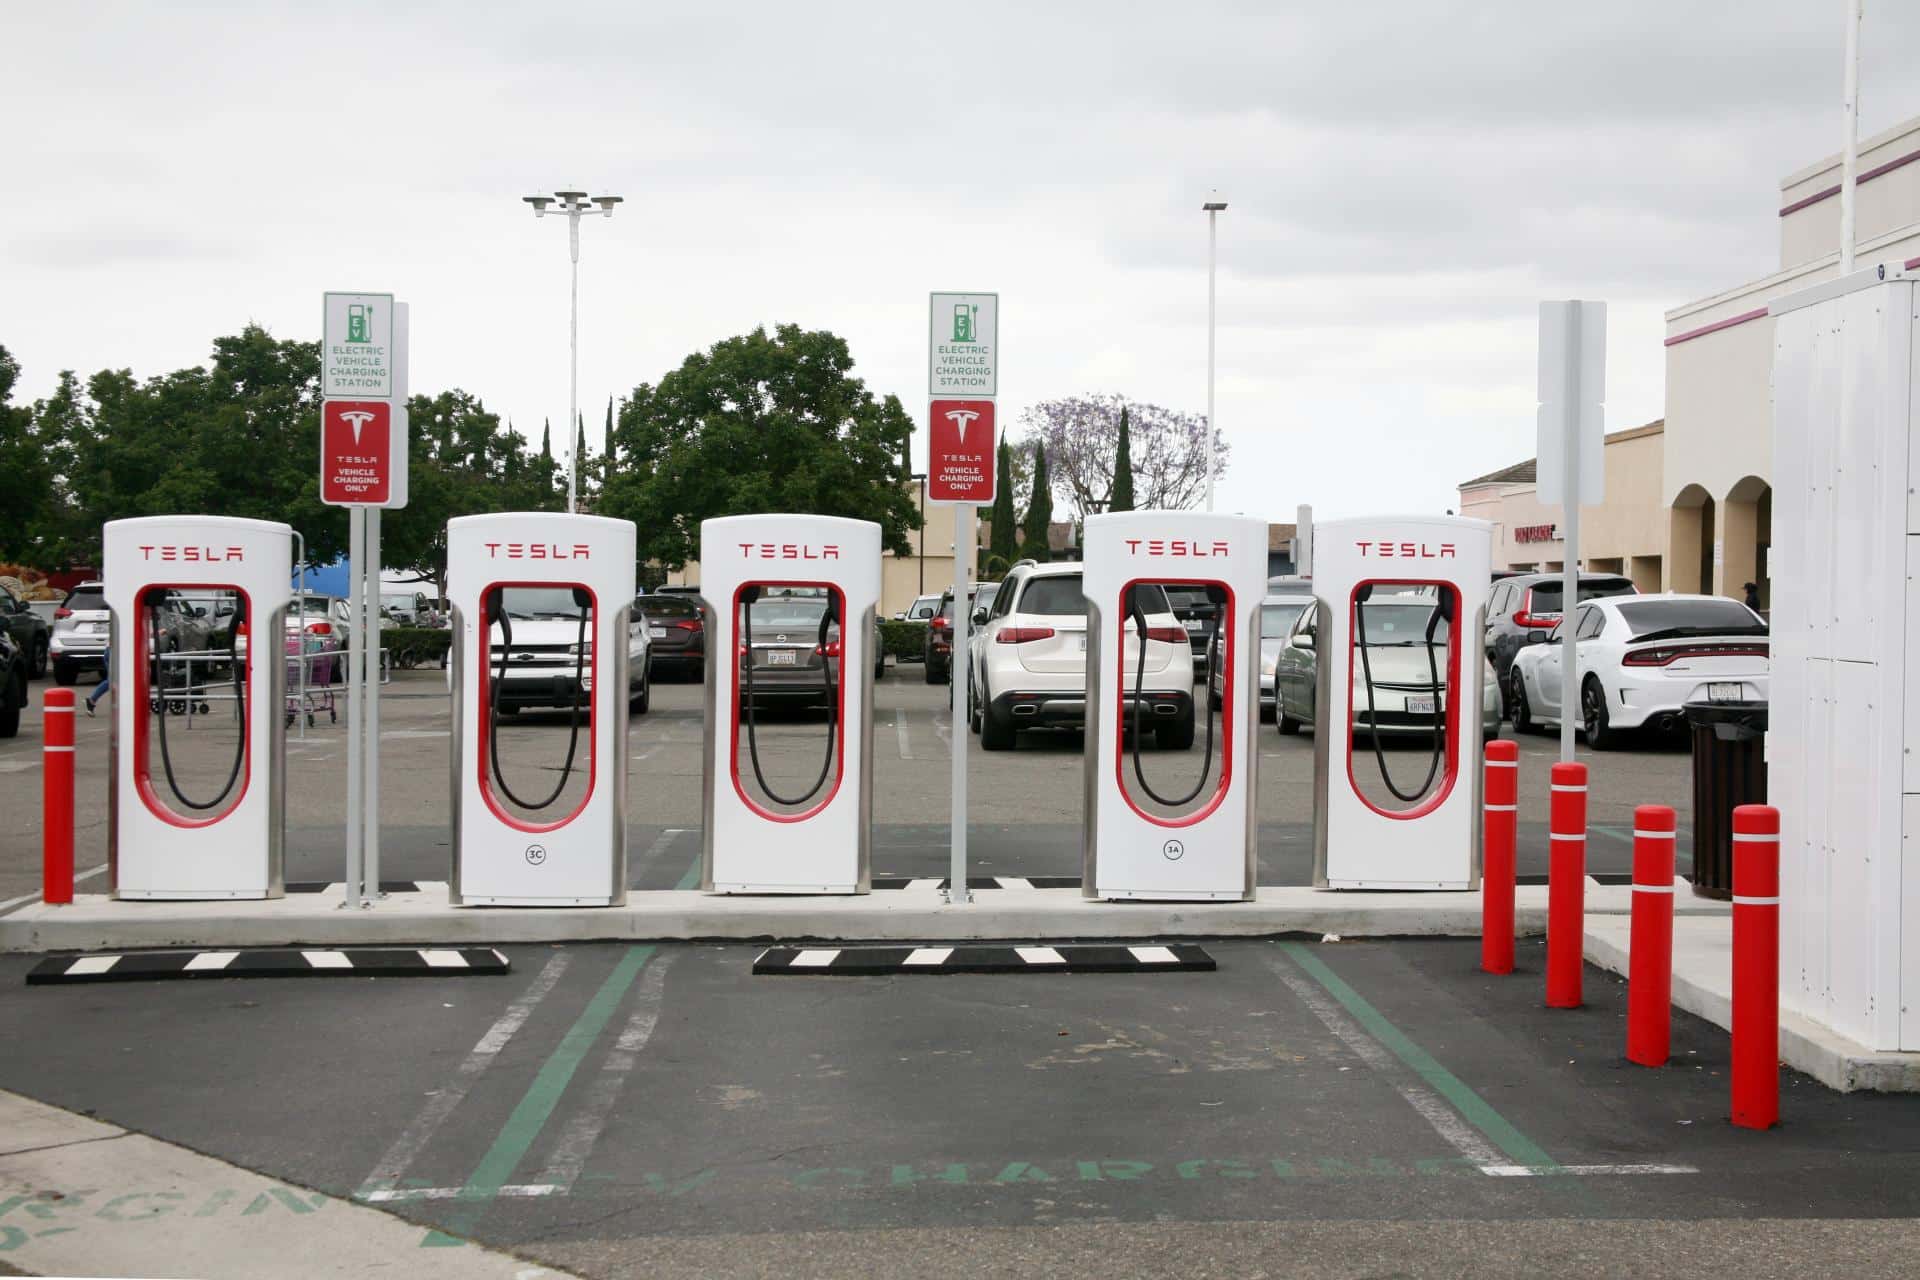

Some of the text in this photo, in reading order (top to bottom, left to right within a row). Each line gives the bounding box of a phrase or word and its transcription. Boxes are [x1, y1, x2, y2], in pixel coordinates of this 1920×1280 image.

[332, 346, 385, 355] ELECTRIC
[938, 345, 989, 354] ELECTRIC
[336, 357, 381, 366] VEHICLE
[941, 356, 985, 365] VEHICLE
[329, 367, 386, 377] CHARGING
[935, 366, 991, 375] CHARGING
[335, 378, 381, 387] STATION
[940, 377, 986, 386] STATION
[943, 454, 982, 462] TESLA
[338, 468, 375, 476] VEHICLE
[333, 476, 380, 484] CHARGING
[939, 474, 984, 482] CHARGING
[485, 544, 590, 560] TESLA
[738, 543, 839, 560] TESLA
[1126, 540, 1229, 557] TESLA
[1356, 542, 1455, 558] TESLA
[139, 546, 243, 562] TESLA
[529, 849, 543, 859] 3C
[1167, 846, 1179, 854] 3A
